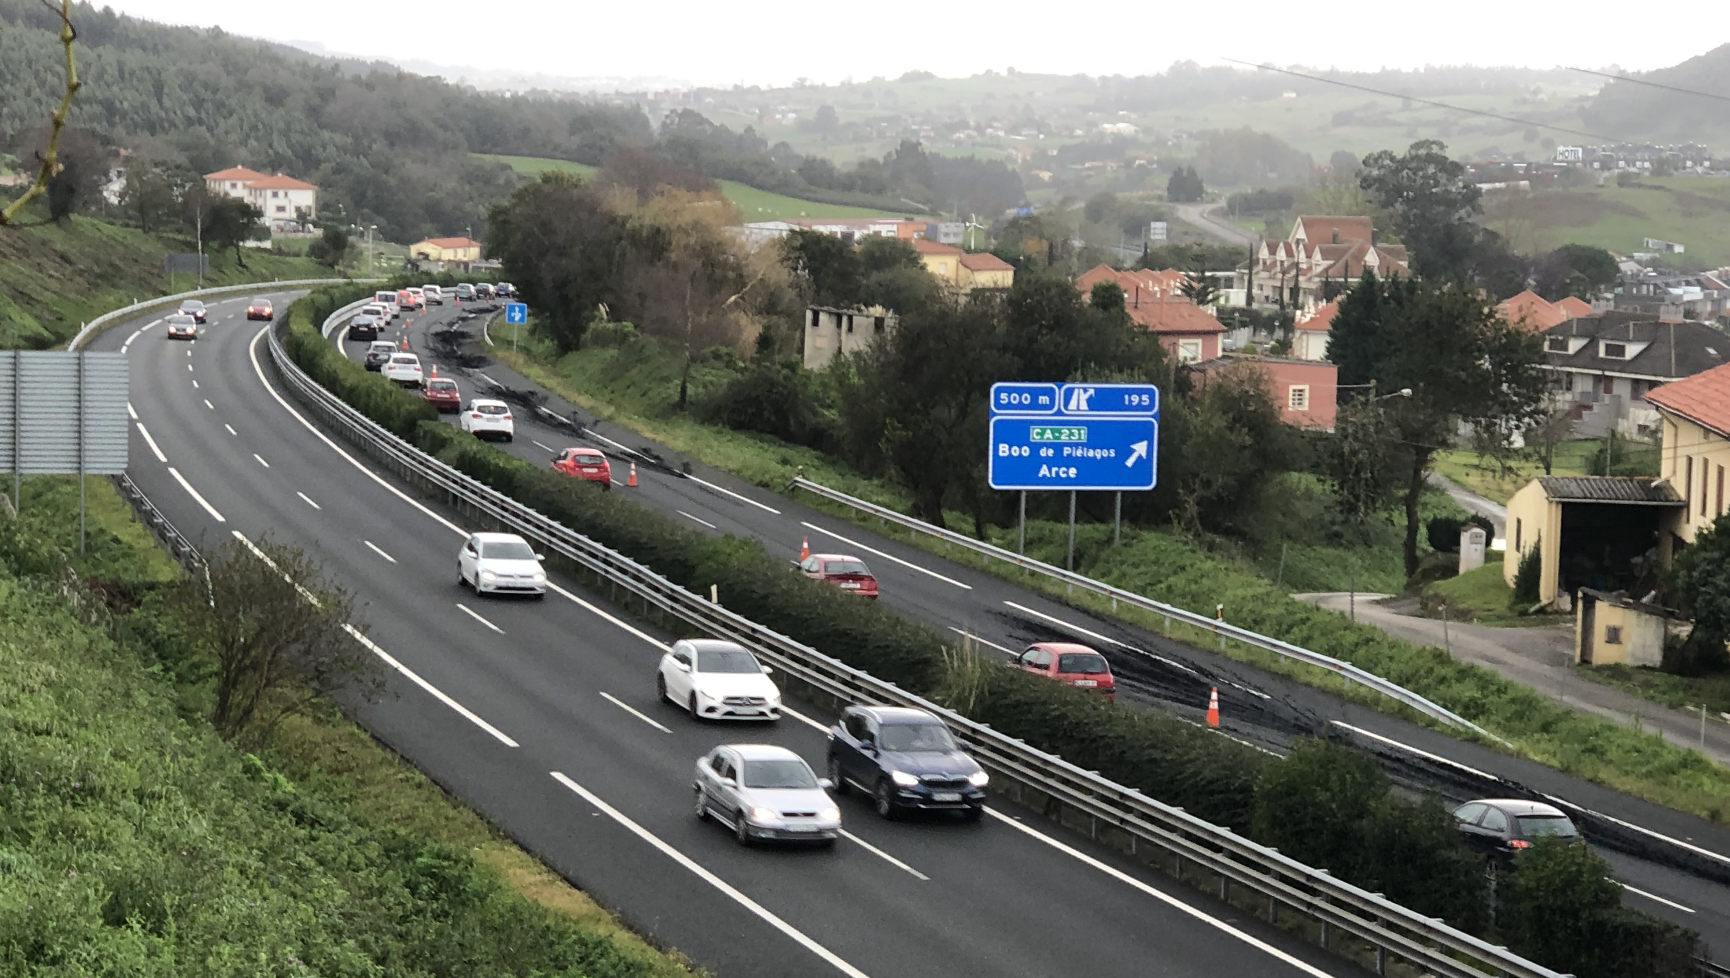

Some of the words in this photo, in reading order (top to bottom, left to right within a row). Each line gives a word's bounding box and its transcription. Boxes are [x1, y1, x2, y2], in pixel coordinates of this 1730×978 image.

[1558, 149, 1580, 160] HOTEL
[999, 393, 1031, 405] 500
[1038, 396, 1050, 405] m
[1124, 394, 1150, 406] 195
[1032, 428, 1085, 440] CA-231
[998, 443, 1030, 457] Boo
[1039, 446, 1054, 457] de
[1063, 446, 1116, 460] Piélagos
[1038, 464, 1078, 478] Arce
